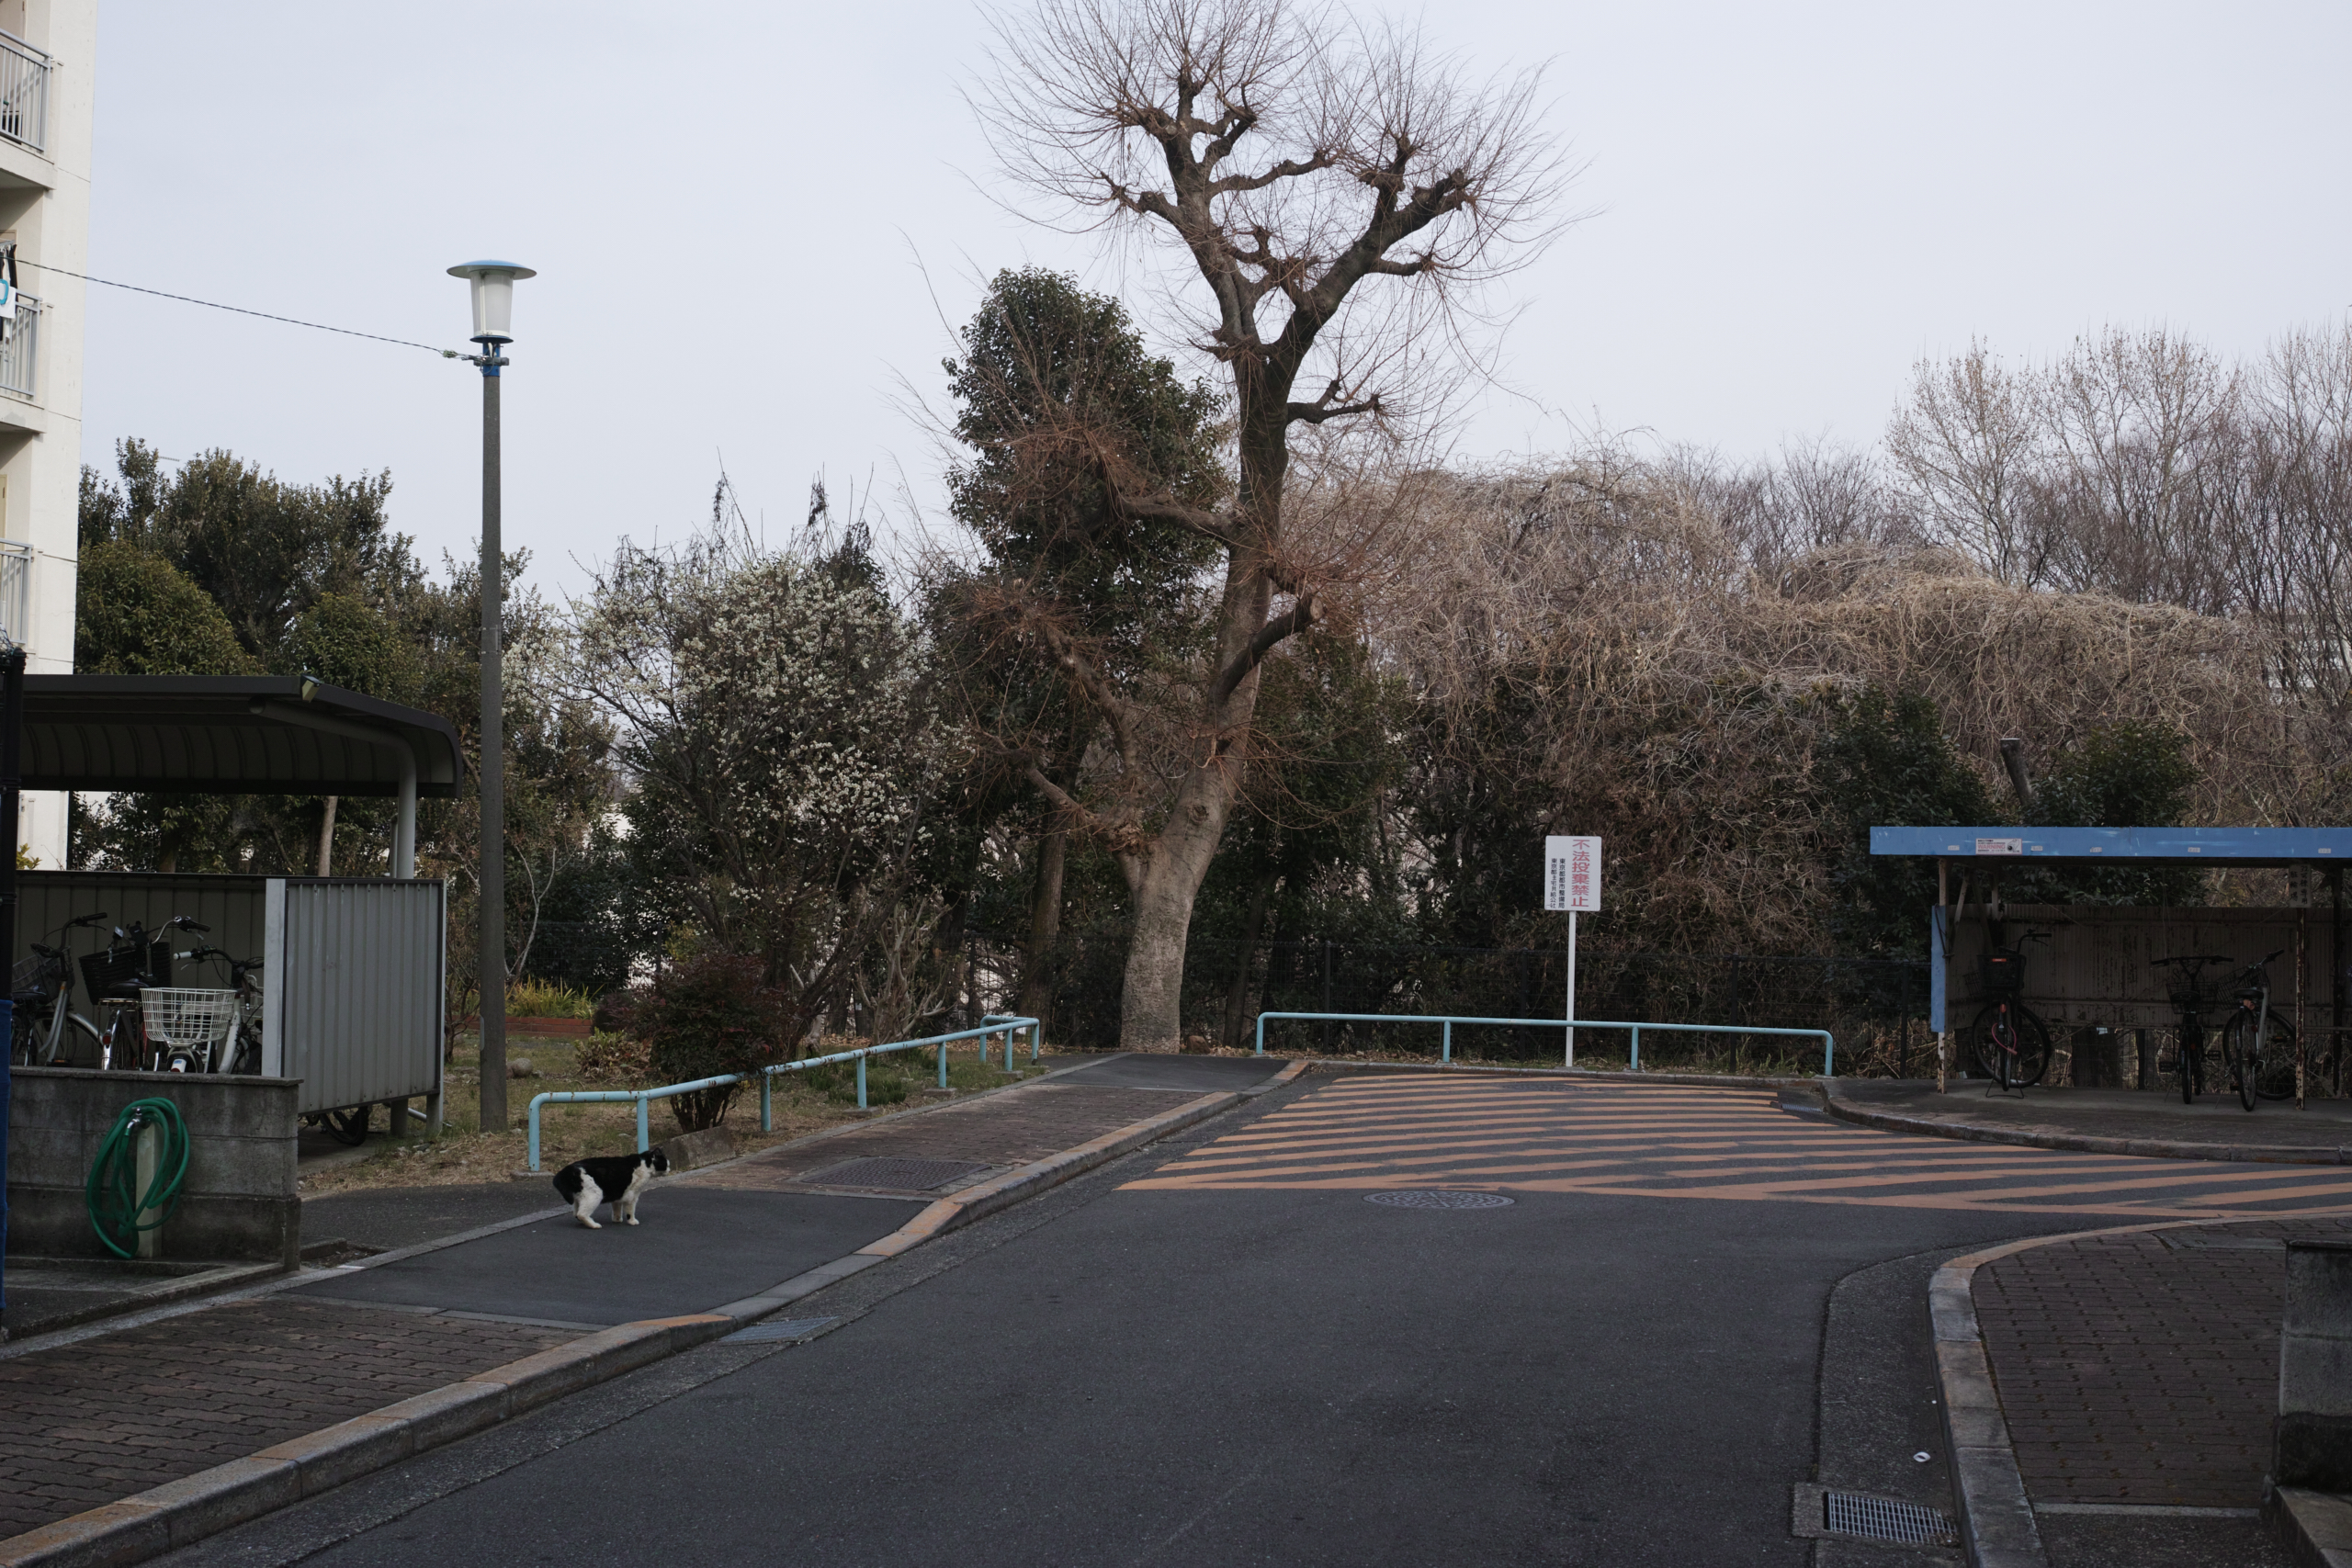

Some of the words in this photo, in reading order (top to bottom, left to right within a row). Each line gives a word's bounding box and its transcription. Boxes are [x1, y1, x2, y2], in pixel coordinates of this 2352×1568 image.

[1570, 839, 1590, 908] 不法投棄禁止
